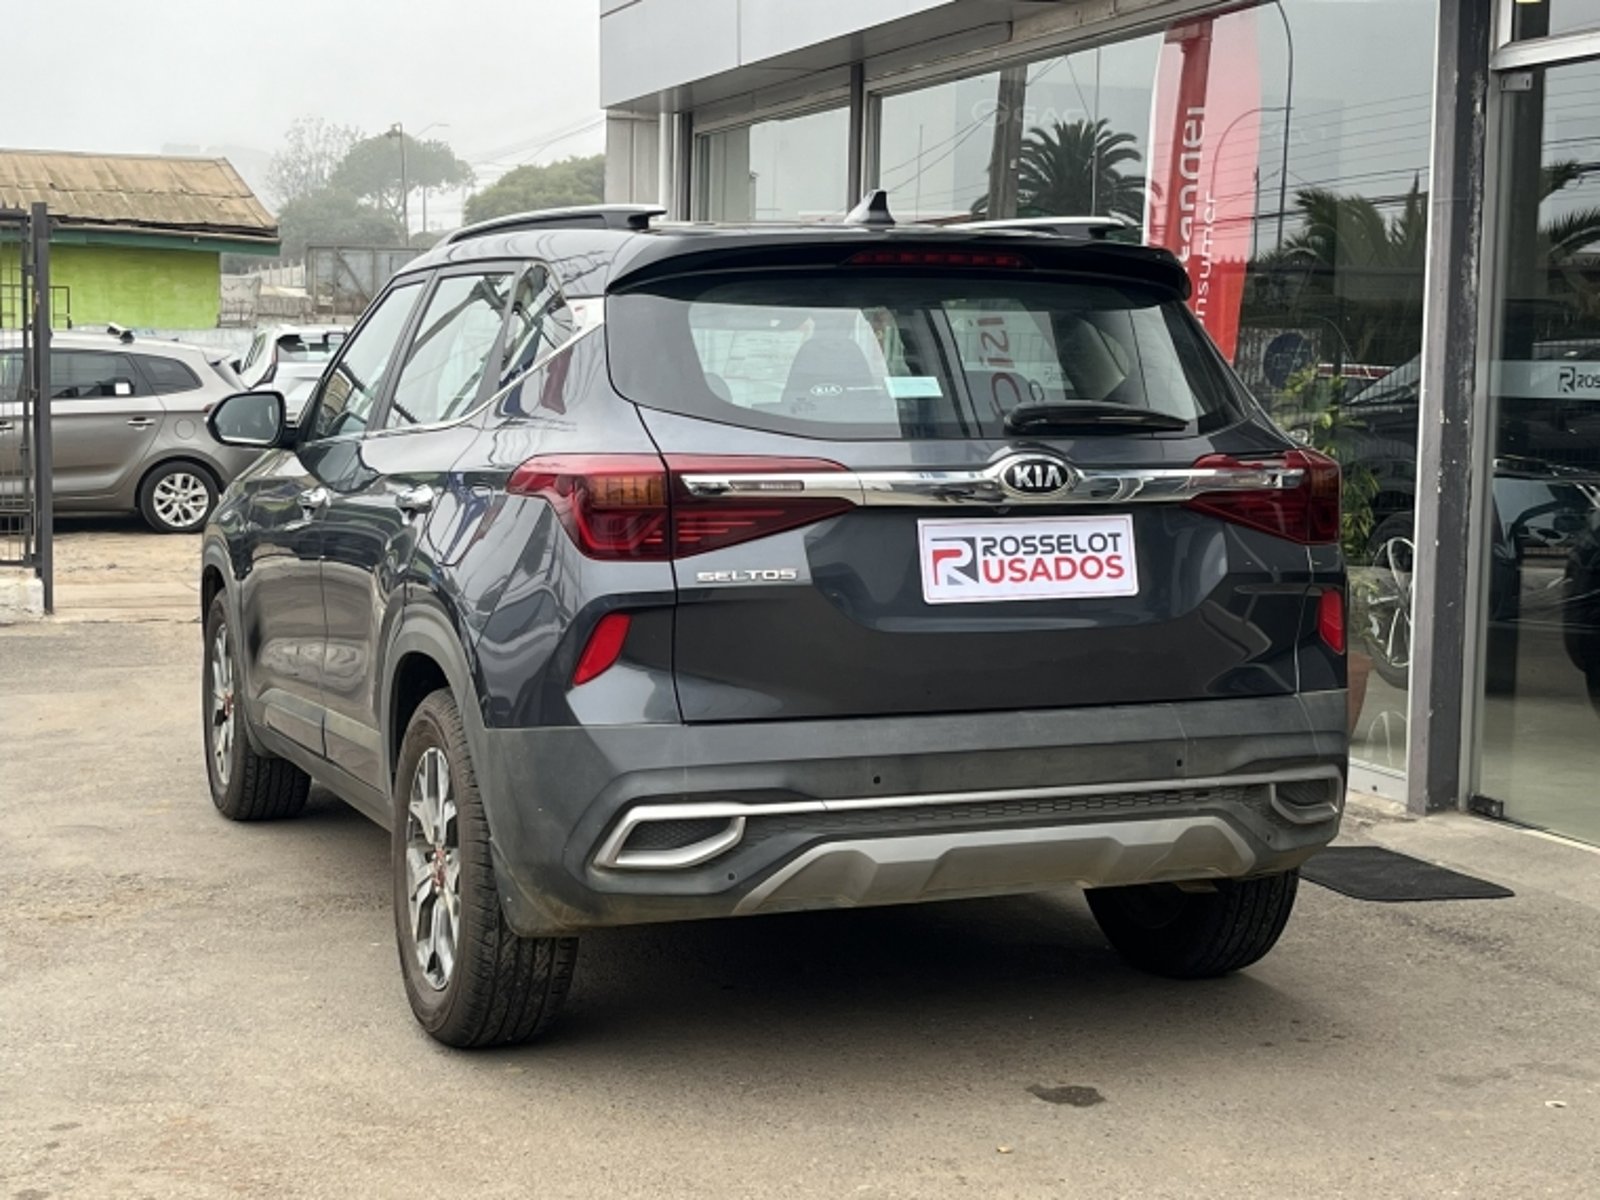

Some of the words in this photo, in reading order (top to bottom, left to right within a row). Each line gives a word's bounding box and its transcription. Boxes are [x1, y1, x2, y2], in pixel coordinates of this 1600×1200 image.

[1195, 189, 1218, 325] nsumer
[1013, 464, 1063, 488] KIA
[981, 532, 1122, 556] ROSSELOT
[697, 568, 798, 583] SELTOS
[983, 555, 1124, 584] USADOS
